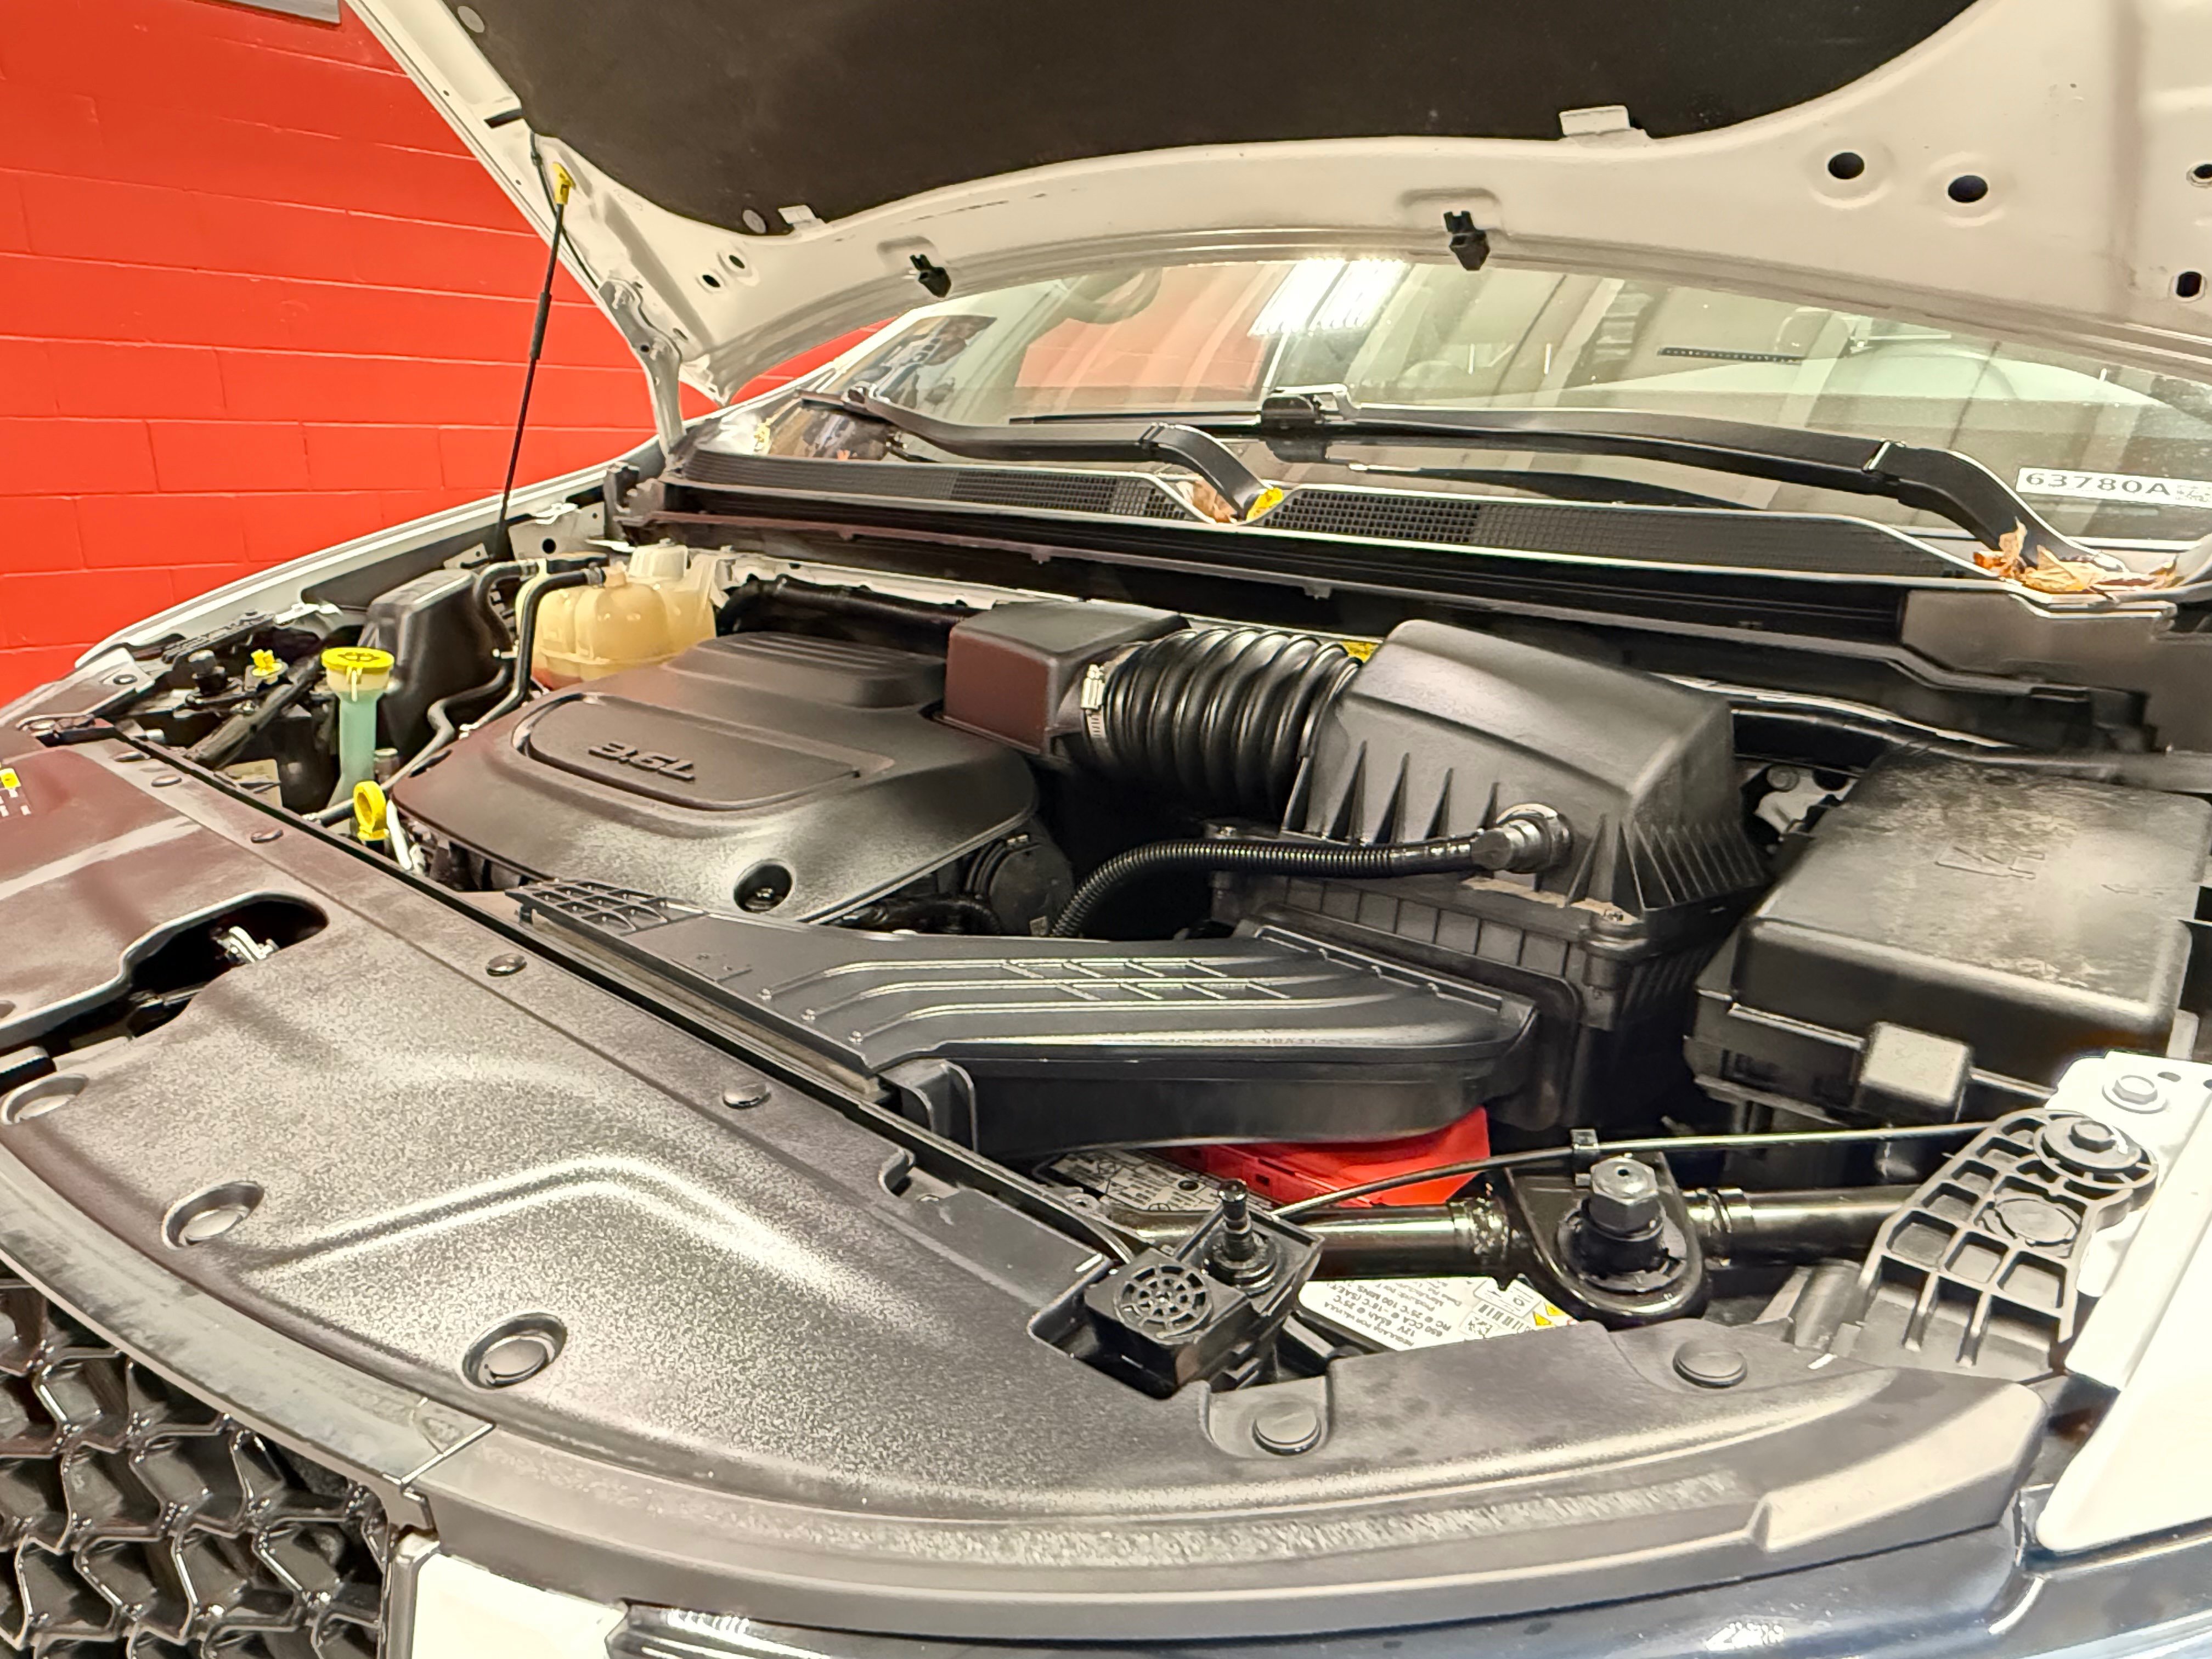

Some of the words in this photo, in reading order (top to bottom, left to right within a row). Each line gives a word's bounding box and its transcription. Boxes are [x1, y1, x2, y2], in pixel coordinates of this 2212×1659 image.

[2025, 472, 2171, 496] 63780A
[588, 741, 696, 782] 3.6L
[1403, 1316, 1424, 1330] CCA
